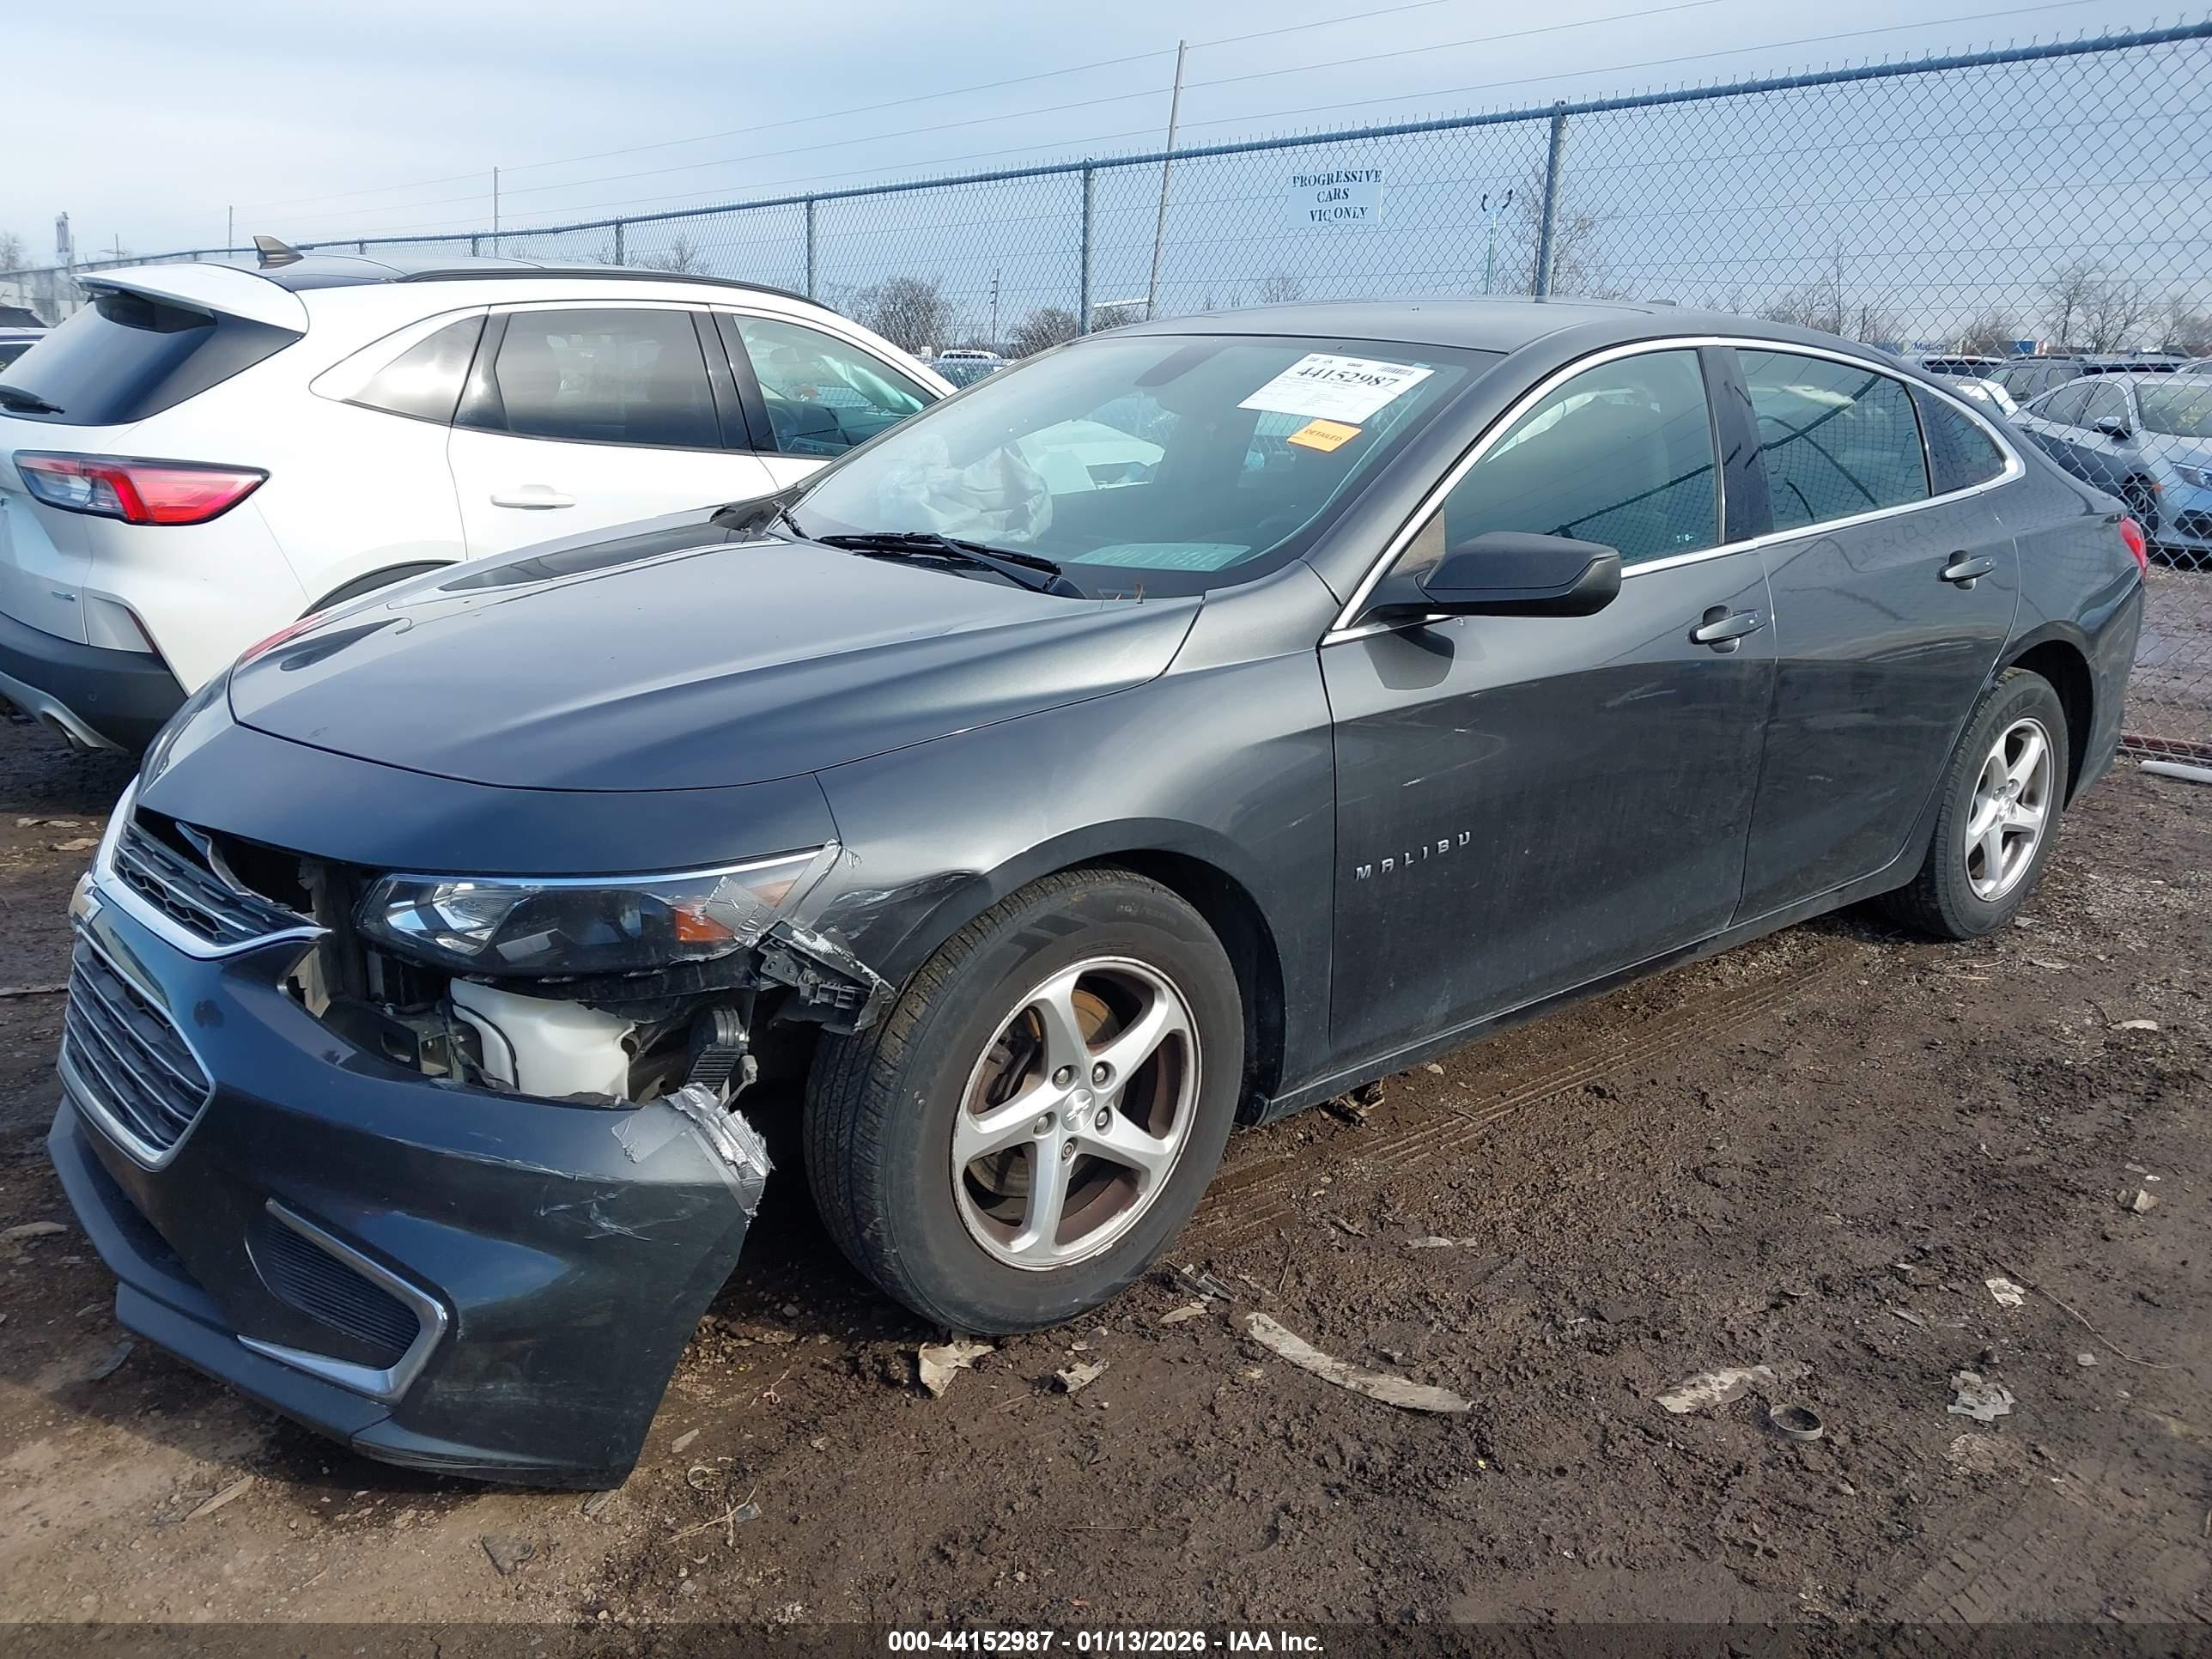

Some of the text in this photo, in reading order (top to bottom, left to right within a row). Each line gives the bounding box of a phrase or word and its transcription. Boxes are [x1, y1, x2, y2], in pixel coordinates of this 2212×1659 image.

[1292, 169, 1382, 188] PROGRESSIVE
[1316, 187, 1350, 204] CARS
[1334, 206, 1368, 220] ONLY
[1297, 366, 1400, 387] 44152987
[1304, 428, 1343, 442] DETAILED
[1355, 831, 1471, 881] MALIBU
